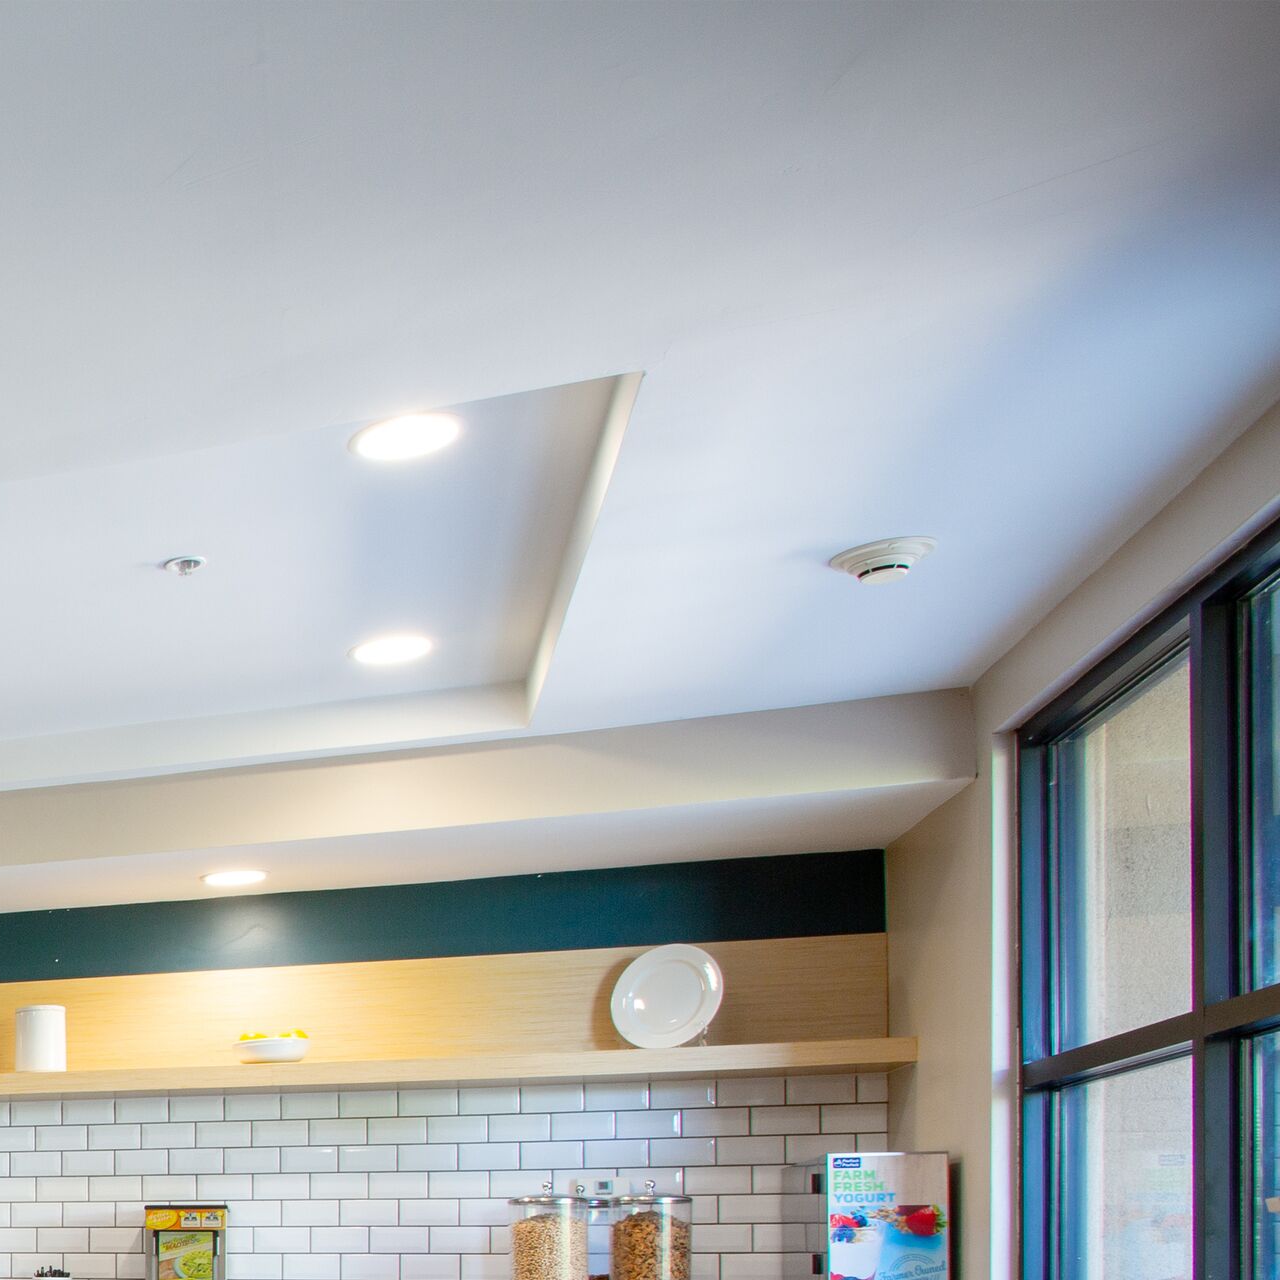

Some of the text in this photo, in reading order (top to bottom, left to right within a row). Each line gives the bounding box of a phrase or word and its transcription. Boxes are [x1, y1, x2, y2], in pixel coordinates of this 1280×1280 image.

[833, 1170, 876, 1181] FARM
[833, 1181, 884, 1192] FRESH
[833, 1192, 896, 1203] YOGURT
